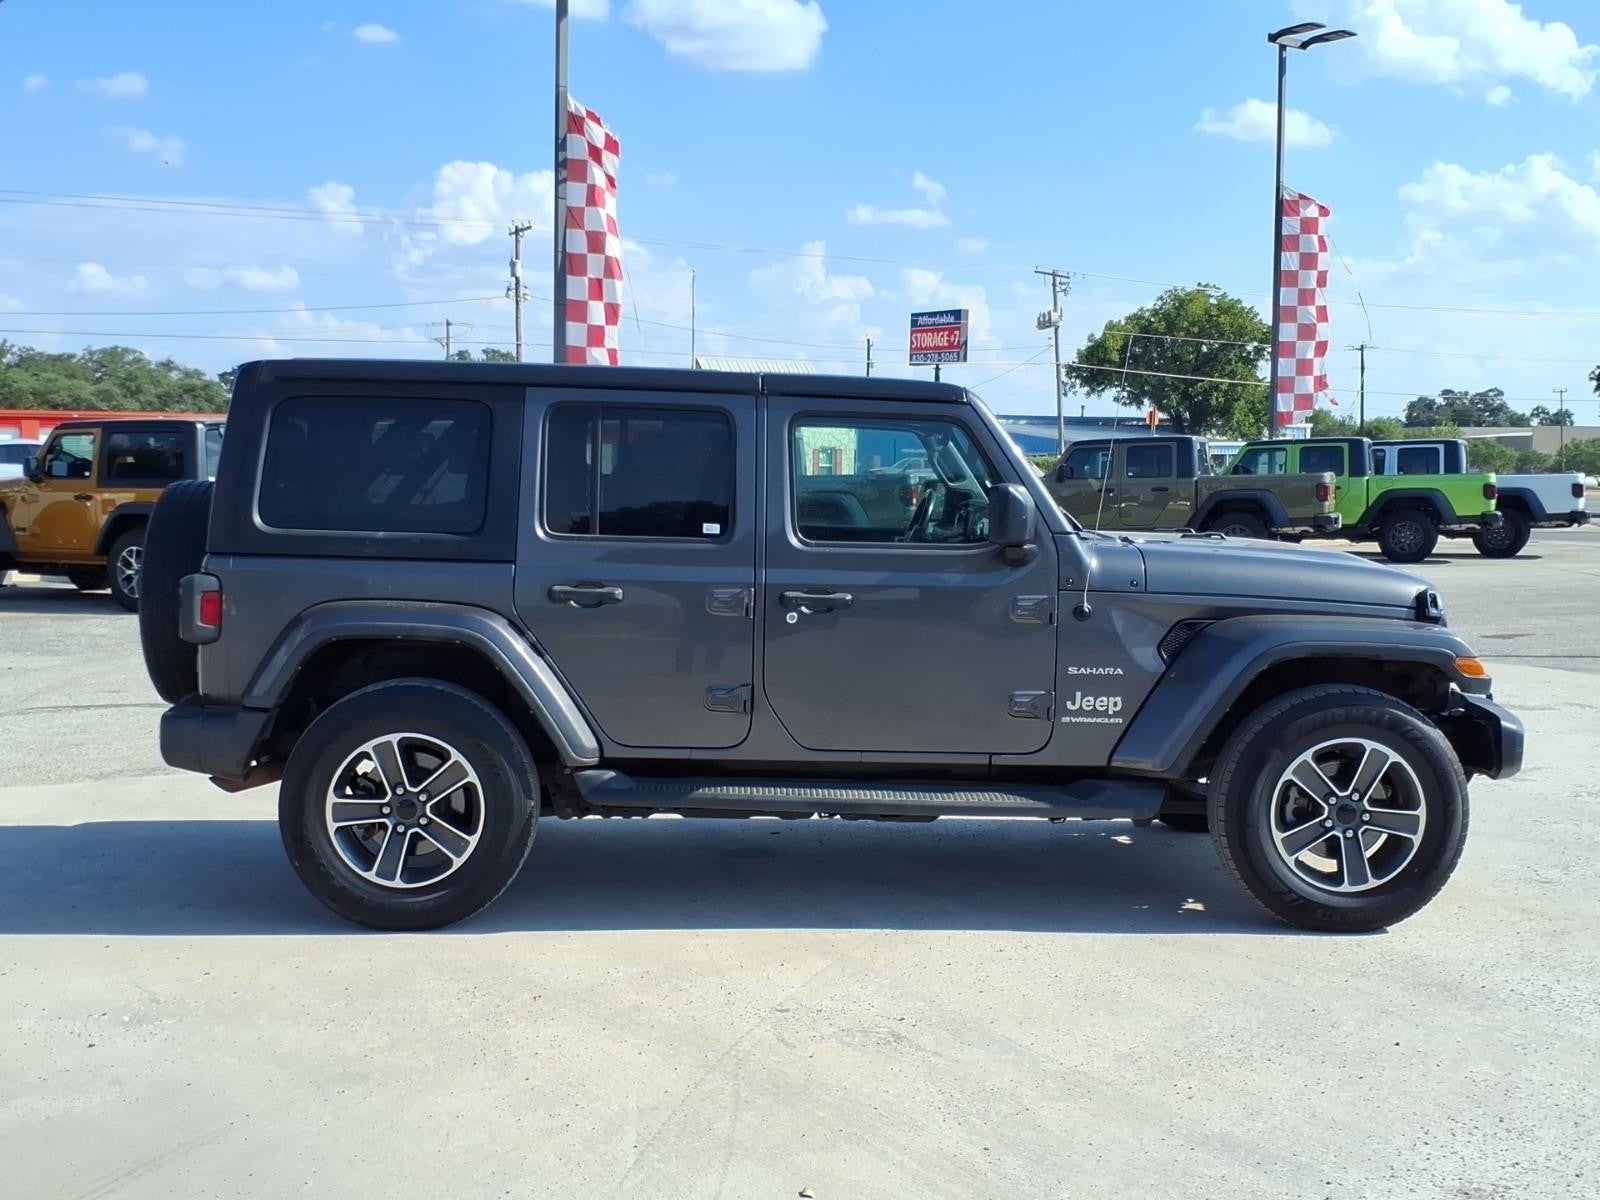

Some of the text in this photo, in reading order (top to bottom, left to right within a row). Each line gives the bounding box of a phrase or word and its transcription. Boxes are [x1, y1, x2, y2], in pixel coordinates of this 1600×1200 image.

[917, 314, 955, 326] Affordable
[911, 332, 949, 348] STORAGE
[1067, 667, 1123, 675] SAHARA
[1066, 691, 1122, 715] Jeep
[1070, 716, 1123, 724] WRANGLER
